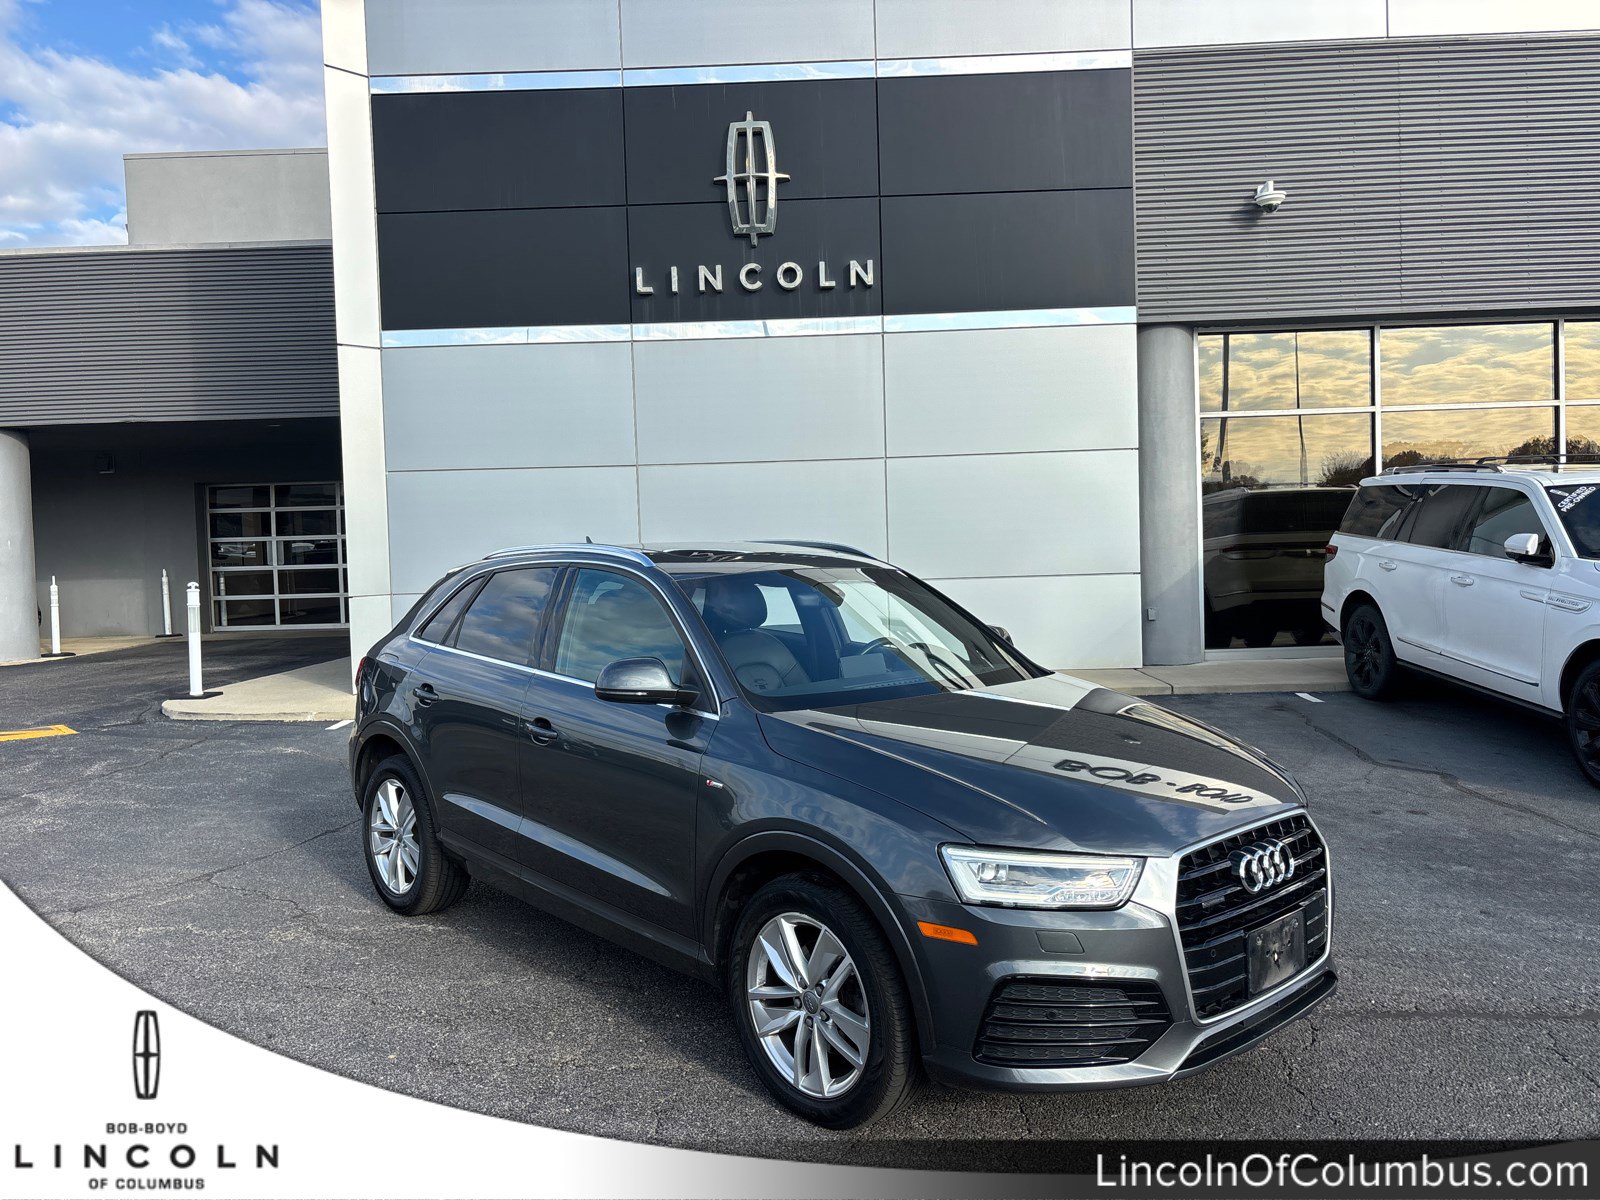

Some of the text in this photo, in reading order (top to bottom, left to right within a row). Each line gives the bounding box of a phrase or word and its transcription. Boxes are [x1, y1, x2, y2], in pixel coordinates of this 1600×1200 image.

[635, 259, 874, 295] LINCOLN
[1557, 486, 1588, 508] CERTIFIED
[1560, 486, 1597, 513] PRE-OWNED
